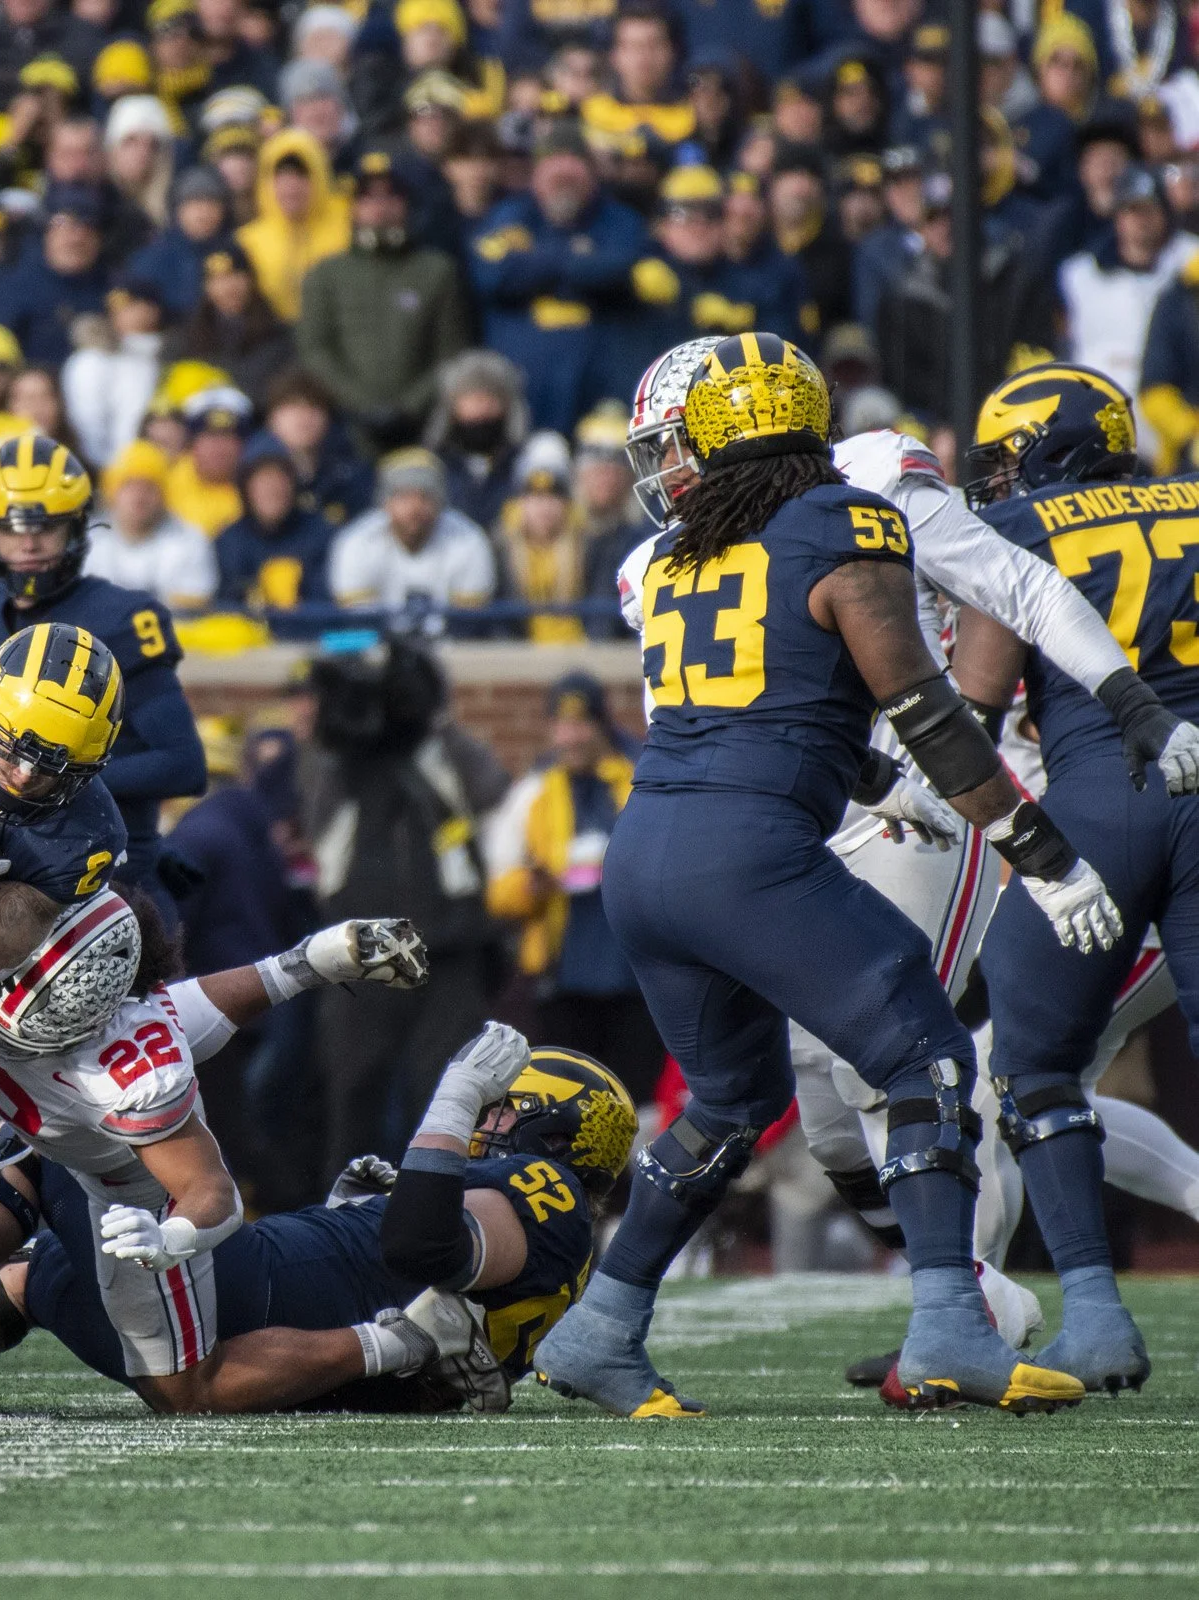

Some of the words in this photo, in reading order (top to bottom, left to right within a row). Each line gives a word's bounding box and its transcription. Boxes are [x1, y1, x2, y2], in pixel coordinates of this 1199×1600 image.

[848, 506, 909, 556] 53
[133, 610, 167, 658] 9
[643, 542, 769, 708] 53
[75, 850, 113, 896] 2
[98, 1021, 183, 1091] 22
[509, 1161, 576, 1223] 52
